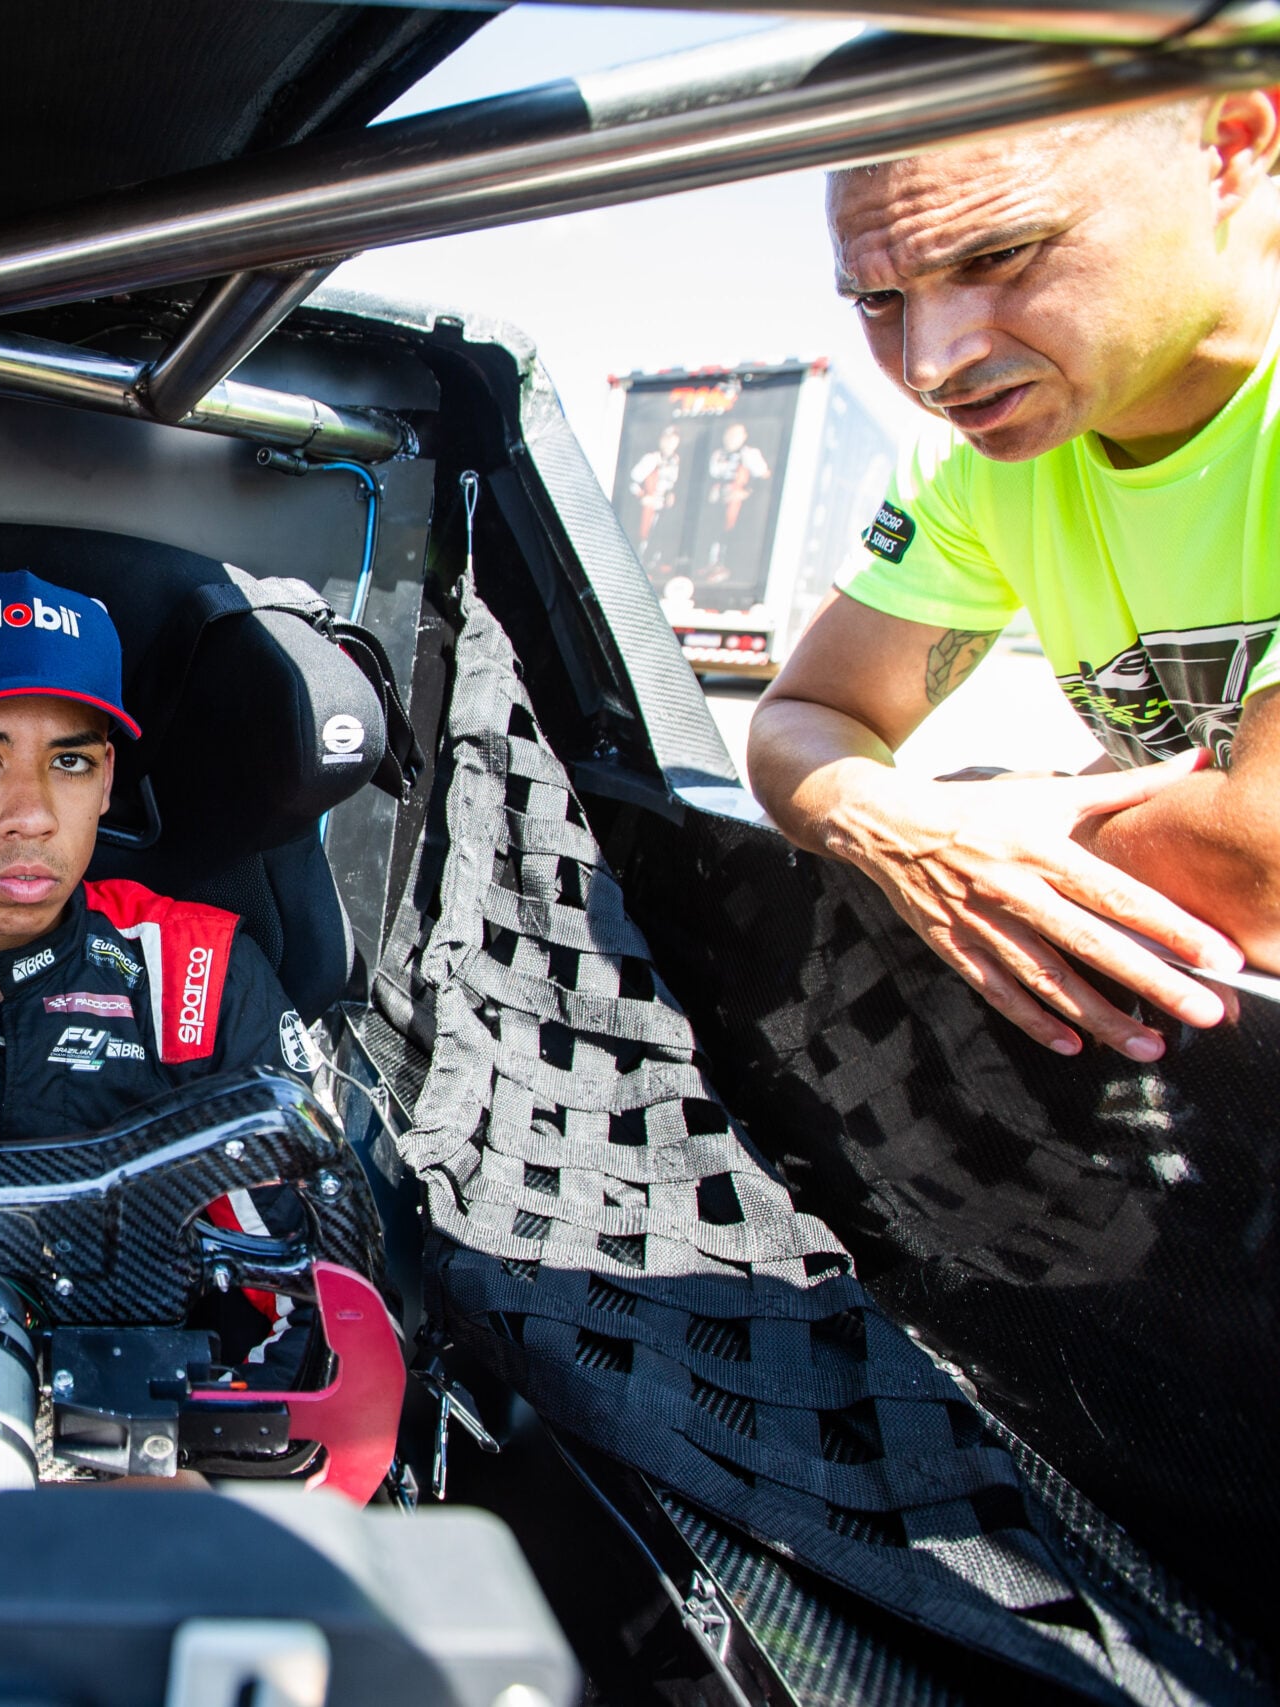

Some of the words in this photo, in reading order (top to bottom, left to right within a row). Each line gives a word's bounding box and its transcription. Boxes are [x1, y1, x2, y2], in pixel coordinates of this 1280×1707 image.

[870, 531, 898, 554] SERIES
[25, 948, 56, 975] BRB
[89, 951, 115, 965] moving
[91, 938, 144, 974] Europcar
[178, 946, 212, 1045] sparco
[57, 1026, 107, 1050] F4
[52, 1046, 94, 1056] BRAZILIAN
[120, 1042, 145, 1061] BRB
